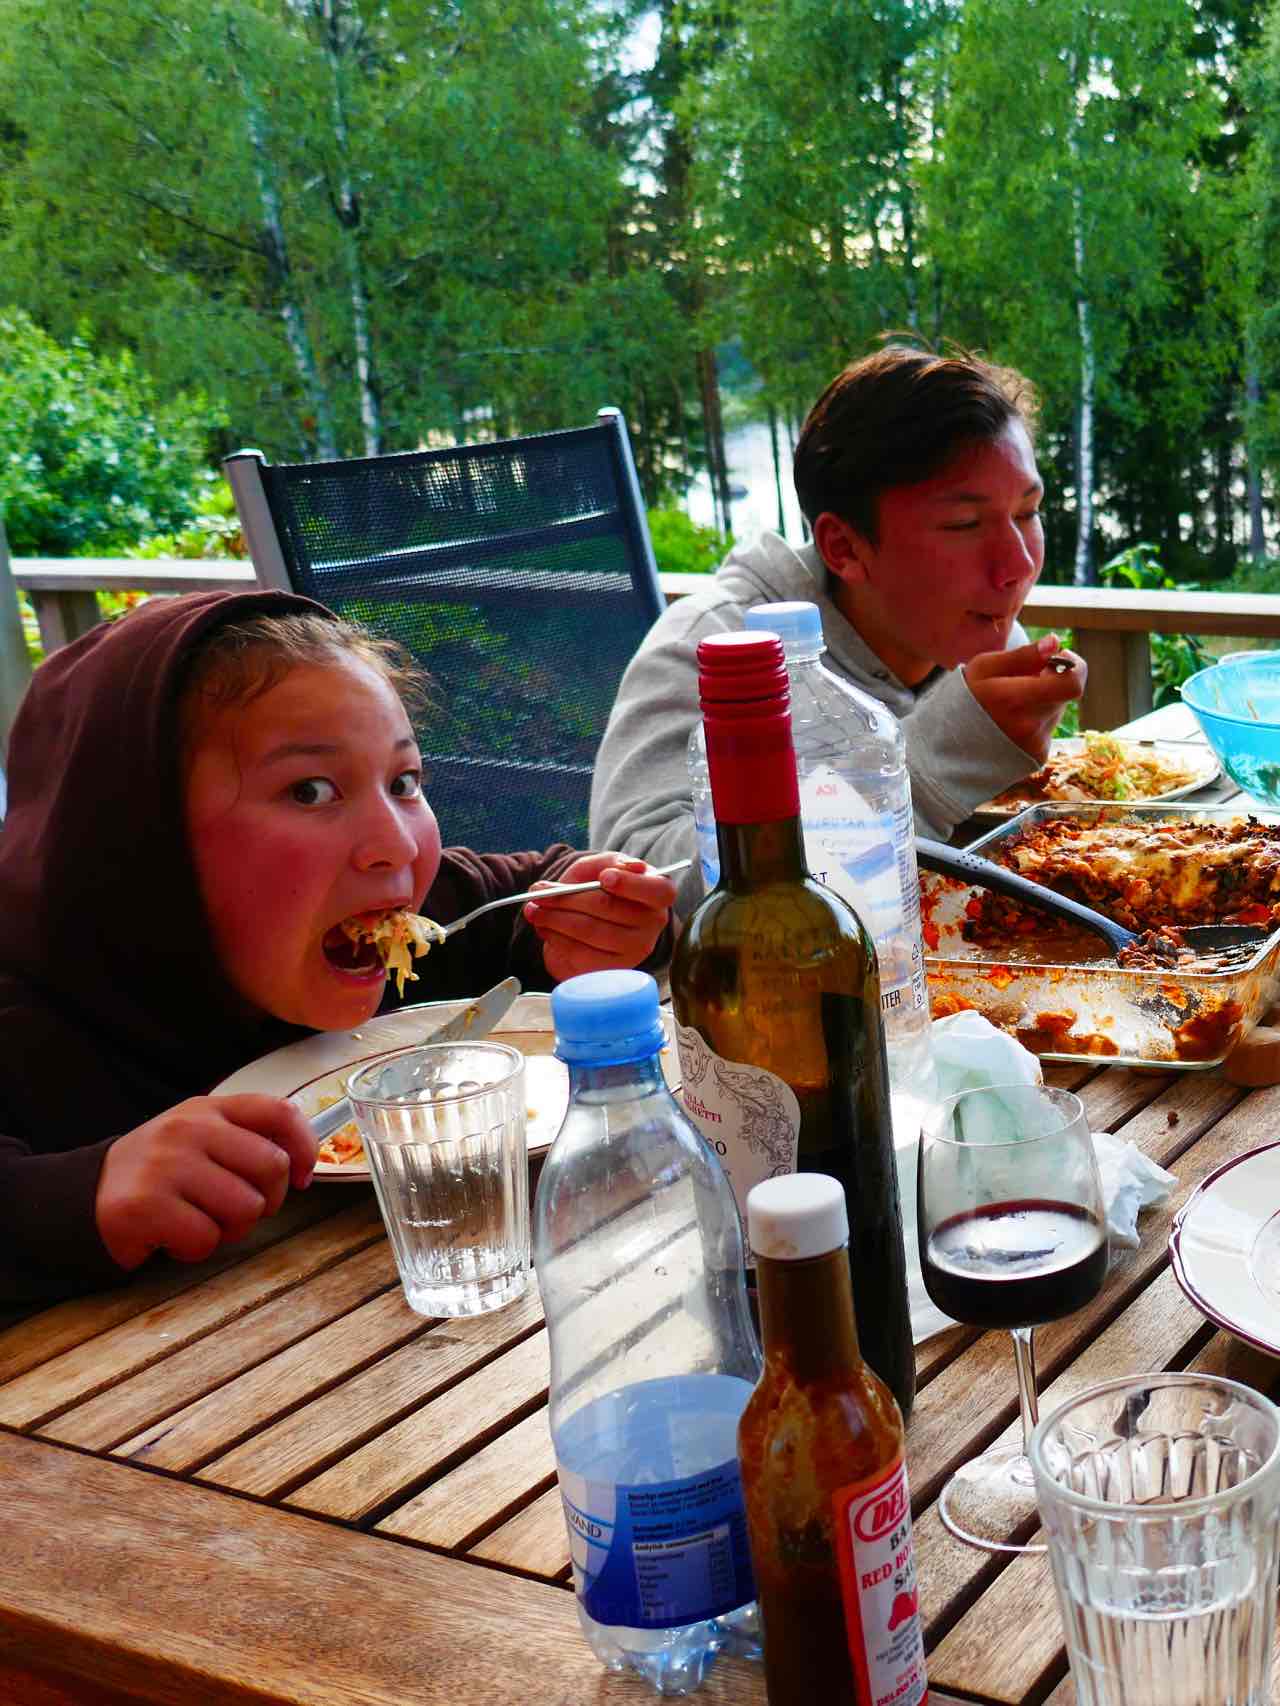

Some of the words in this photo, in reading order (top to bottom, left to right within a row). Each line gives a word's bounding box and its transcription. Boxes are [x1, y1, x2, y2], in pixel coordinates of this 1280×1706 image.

[881, 989, 901, 1010] ITER
[862, 1562, 892, 1590] RED
[896, 1544, 912, 1569] HO
